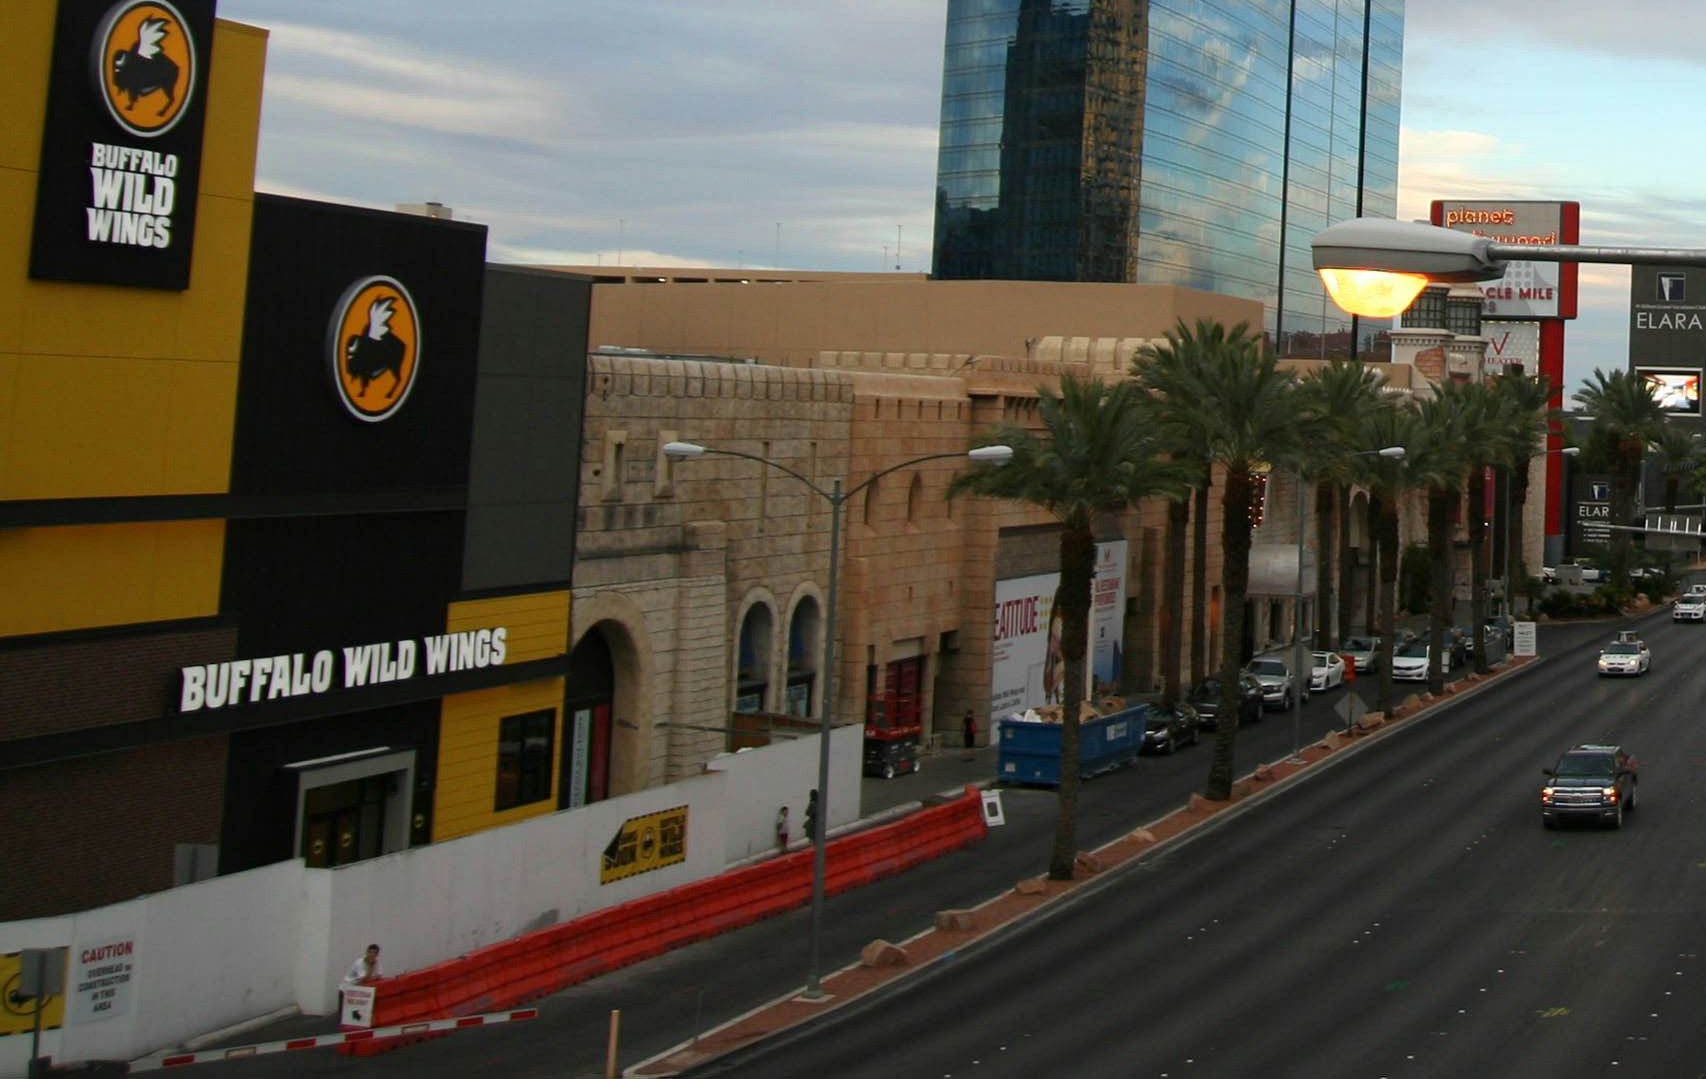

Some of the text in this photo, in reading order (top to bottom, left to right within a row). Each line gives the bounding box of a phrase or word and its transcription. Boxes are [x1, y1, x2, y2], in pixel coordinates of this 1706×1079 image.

[92, 142, 178, 178] BUFFALO
[90, 167, 175, 217] WILD
[86, 207, 172, 249] WINGS
[1446, 205, 1515, 228] planet
[1519, 288, 1554, 300] MILE
[1637, 311, 1703, 330] ELARA
[1490, 331, 1512, 356] V
[1578, 505, 1611, 517] ELAR
[180, 627, 507, 712] BUFFALO WILD WINGS
[81, 941, 133, 964] CAUTION
